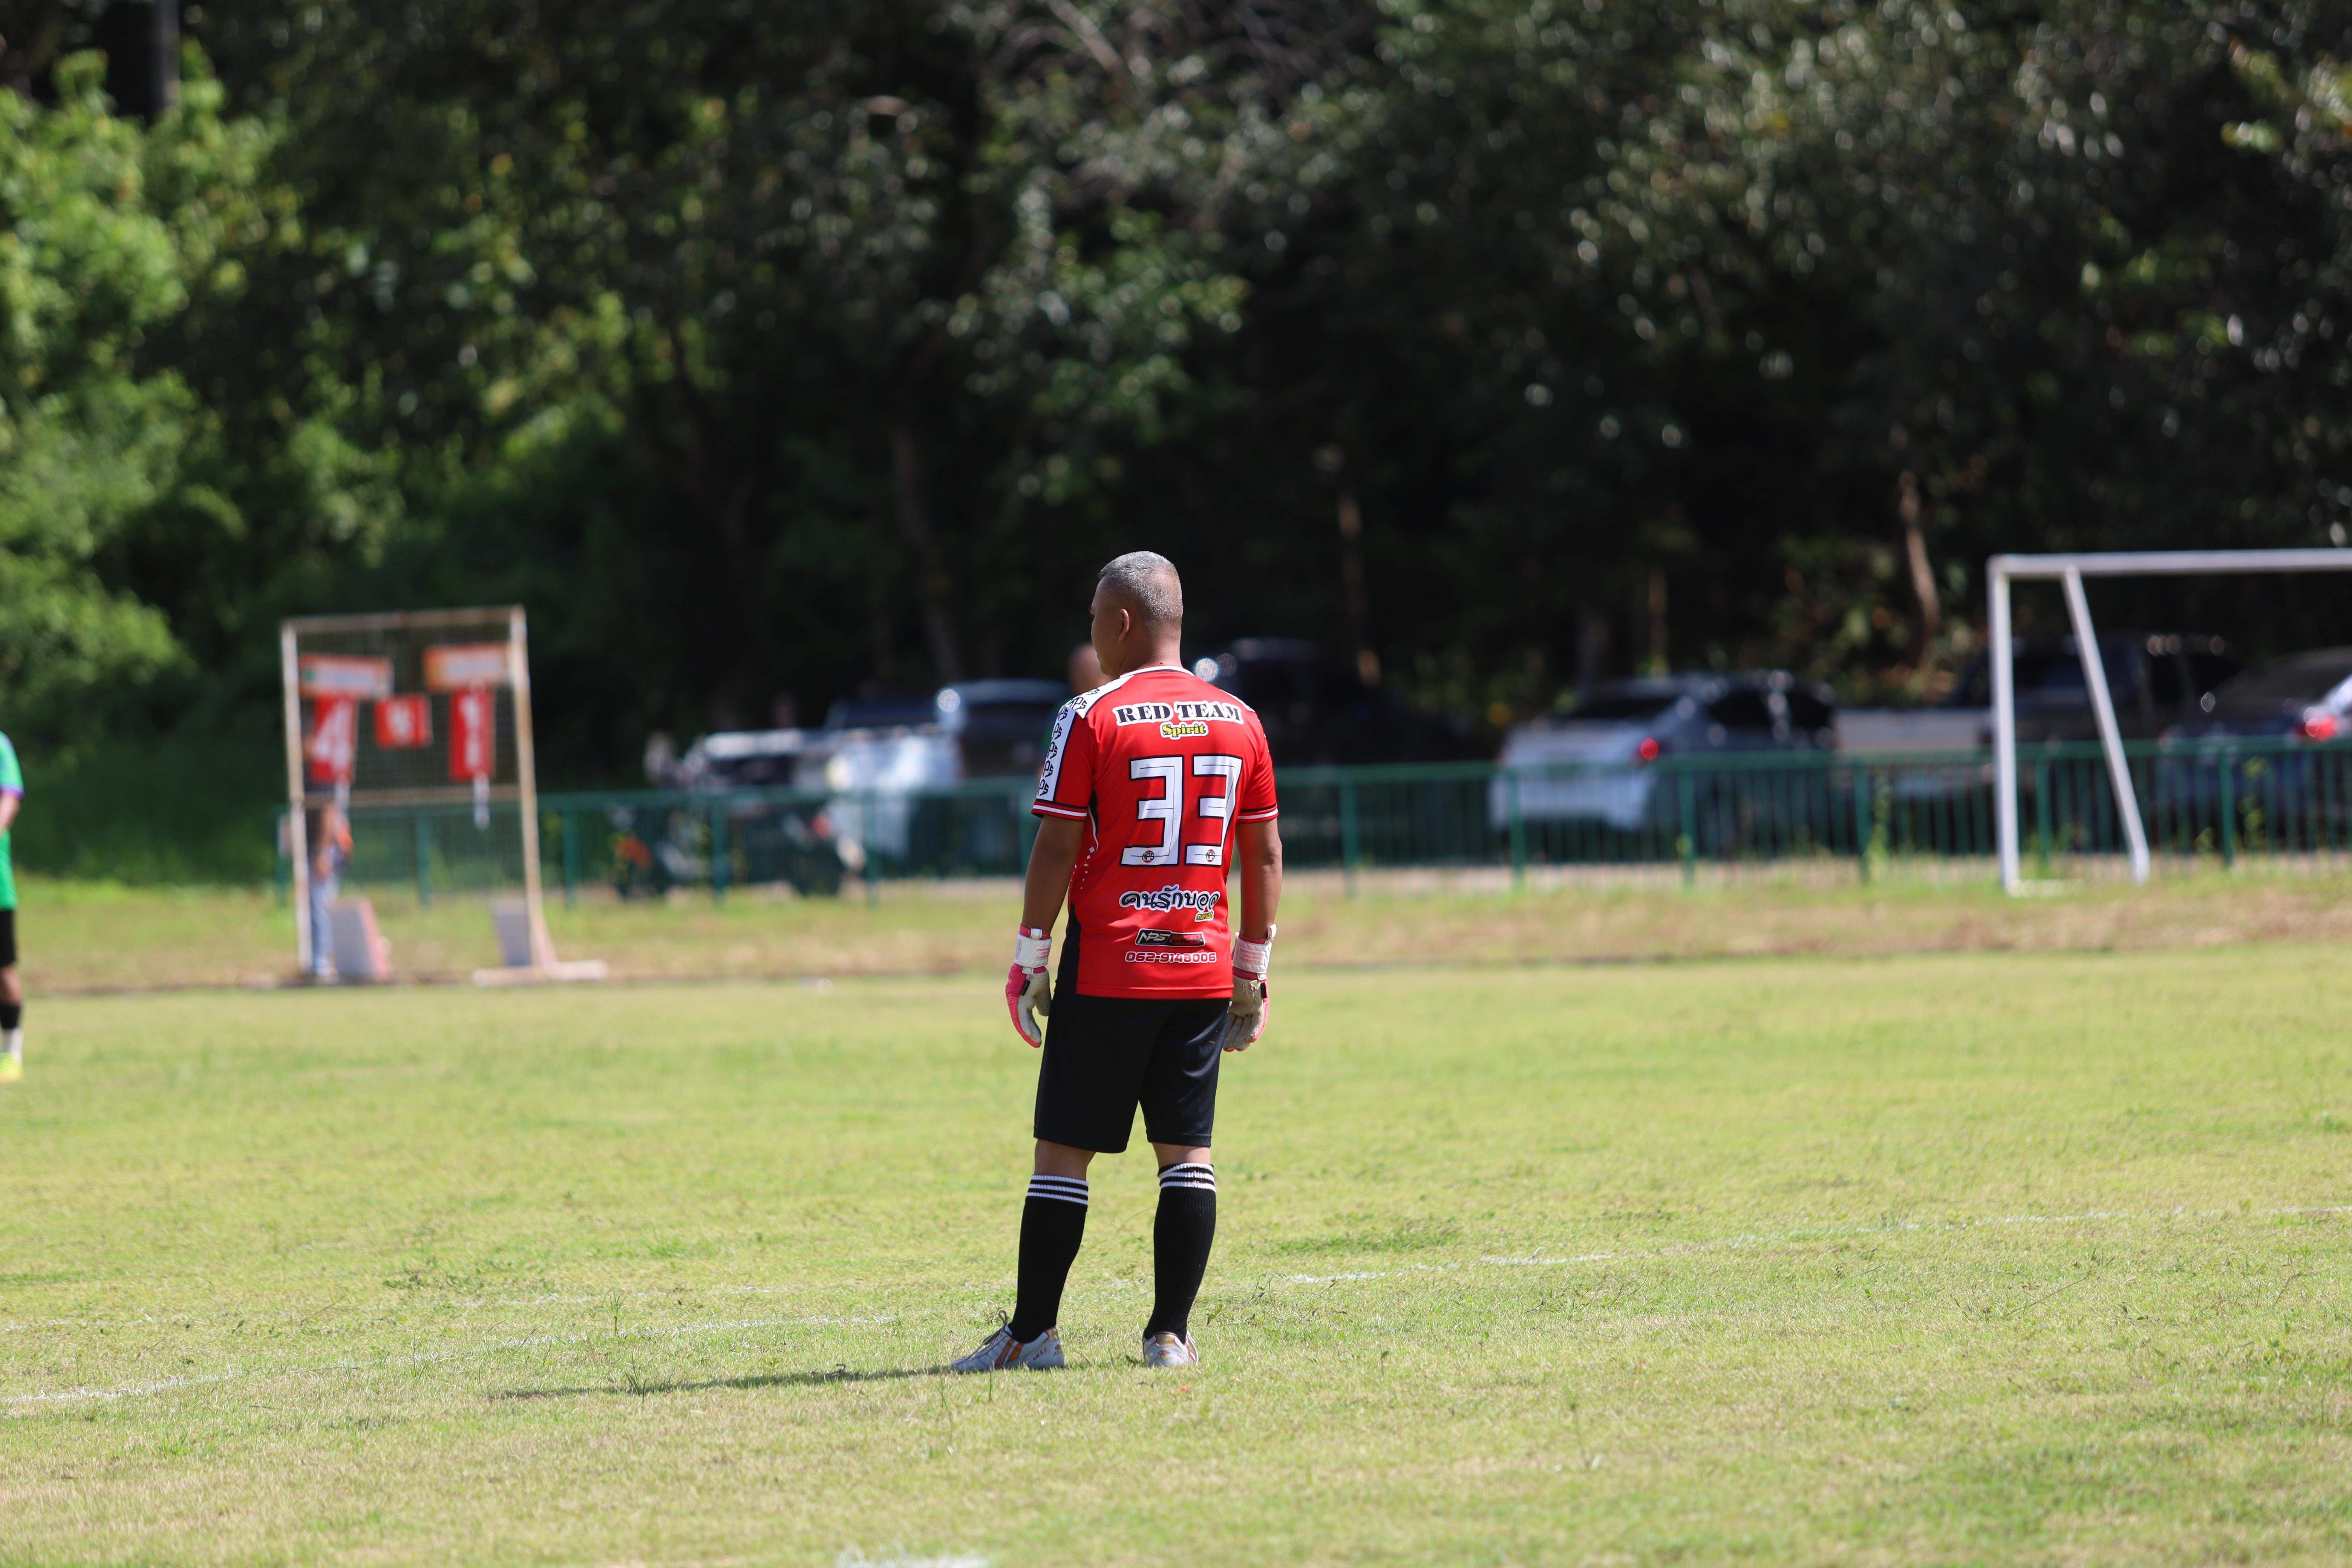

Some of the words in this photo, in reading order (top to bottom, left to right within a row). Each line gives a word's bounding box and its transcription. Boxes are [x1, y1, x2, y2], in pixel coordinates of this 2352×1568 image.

[1116, 705, 1170, 723] RED
[1177, 704, 1242, 722] TEAM
[1162, 724, 1206, 737] Spirit
[1121, 755, 1243, 866] 33
[1206, 851, 1216, 860] NPS
[1137, 932, 1171, 944] NPS
[1126, 952, 1216, 963] 062-9148006
